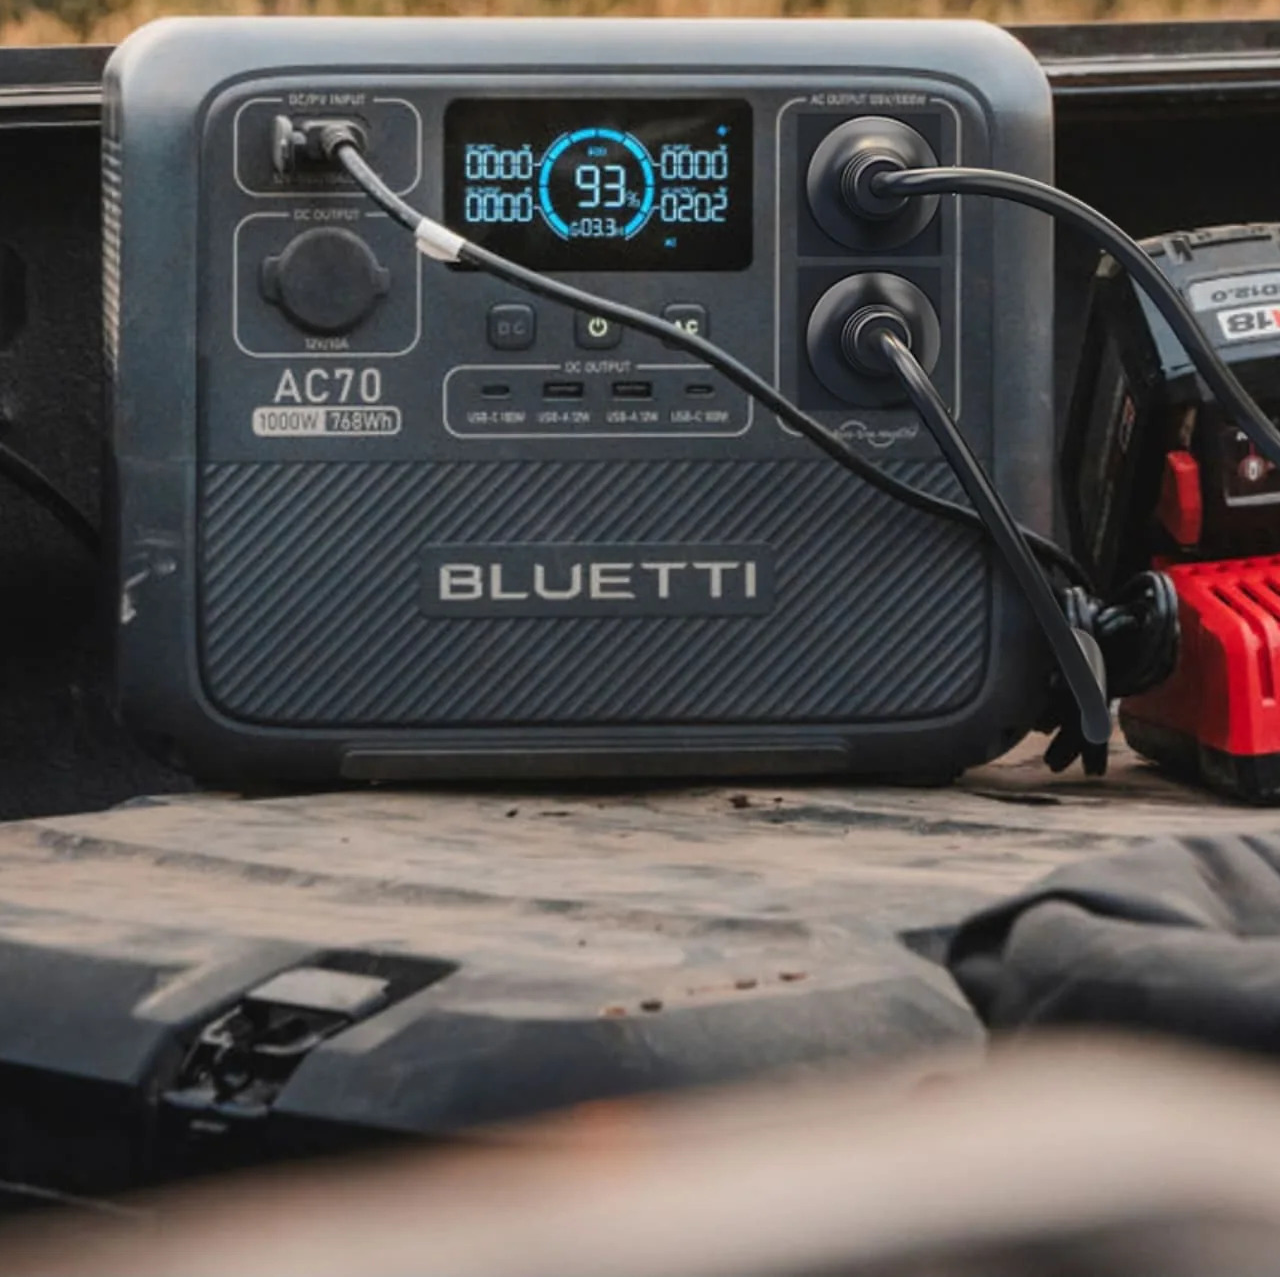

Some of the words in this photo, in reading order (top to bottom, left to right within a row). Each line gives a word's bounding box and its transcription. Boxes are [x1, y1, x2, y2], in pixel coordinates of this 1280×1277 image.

[466, 150, 533, 180] 0000
[660, 150, 728, 180] 0000
[466, 192, 533, 222] 0000
[660, 192, 728, 222] 0202
[584, 360, 631, 373] OUTPUT
[274, 368, 382, 403] AC70
[259, 411, 319, 431] 1000W
[329, 411, 392, 432] 768Wh
[439, 561, 757, 600] BLUETTI
